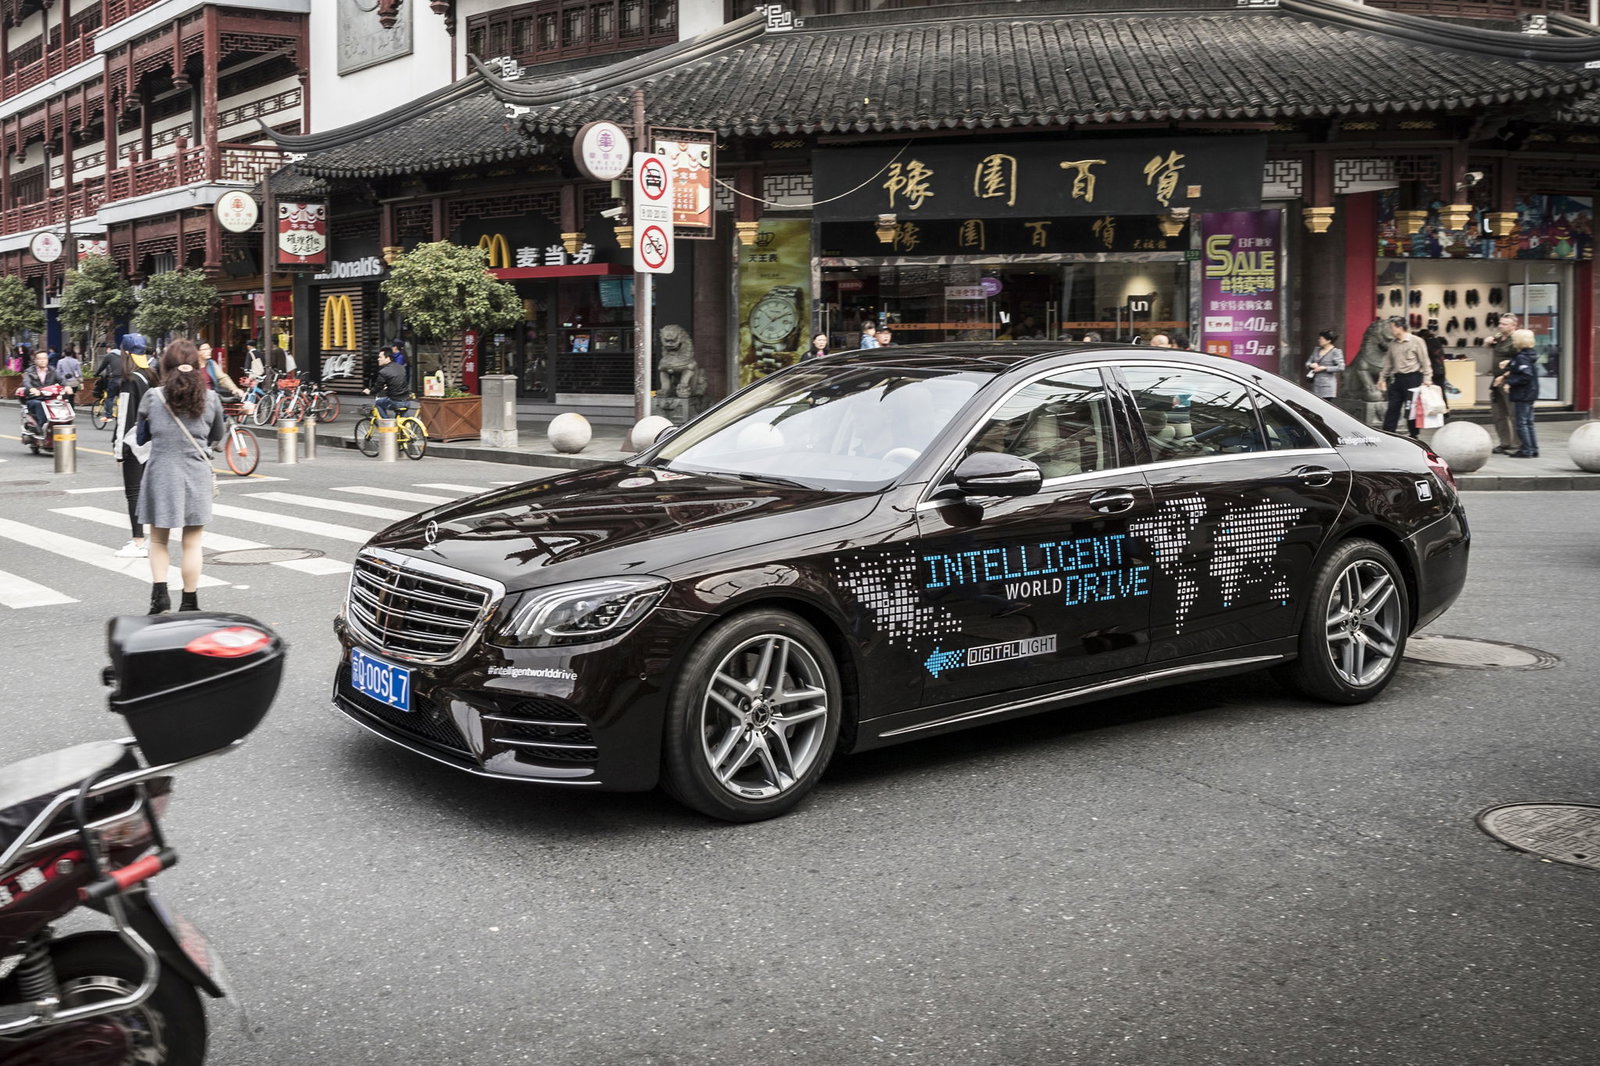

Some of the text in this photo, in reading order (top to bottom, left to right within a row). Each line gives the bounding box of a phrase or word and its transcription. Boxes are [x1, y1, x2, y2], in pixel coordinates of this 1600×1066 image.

[883, 151, 1186, 209] 豫園百貨
[1205, 234, 1275, 277] SALE
[923, 534, 1125, 588] INTELLIGENT
[1005, 565, 1150, 606] WORLD DRIVE
